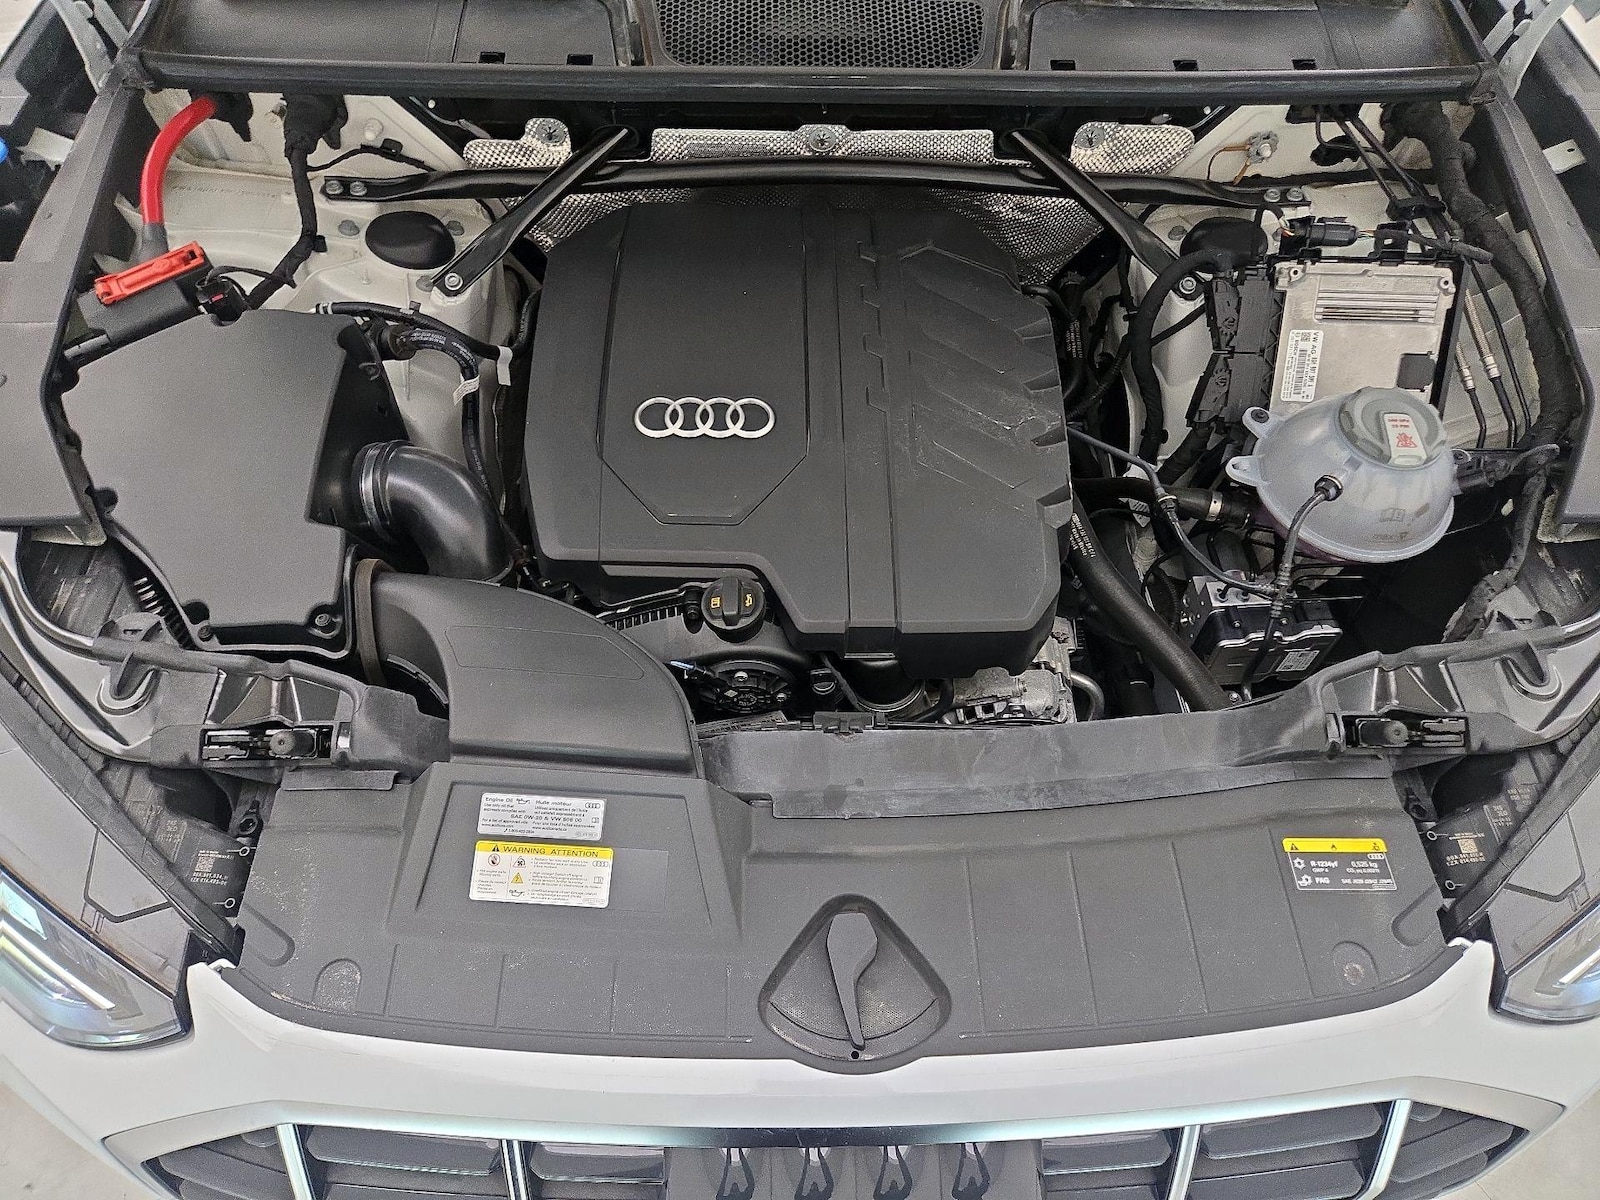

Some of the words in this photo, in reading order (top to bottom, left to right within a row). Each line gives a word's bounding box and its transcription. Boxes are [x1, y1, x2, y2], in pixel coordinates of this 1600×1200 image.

[1312, 331, 1319, 342] VW
[1310, 344, 1316, 354] AG
[503, 845, 546, 854] WARNING
[550, 848, 598, 857] ATTENTION
